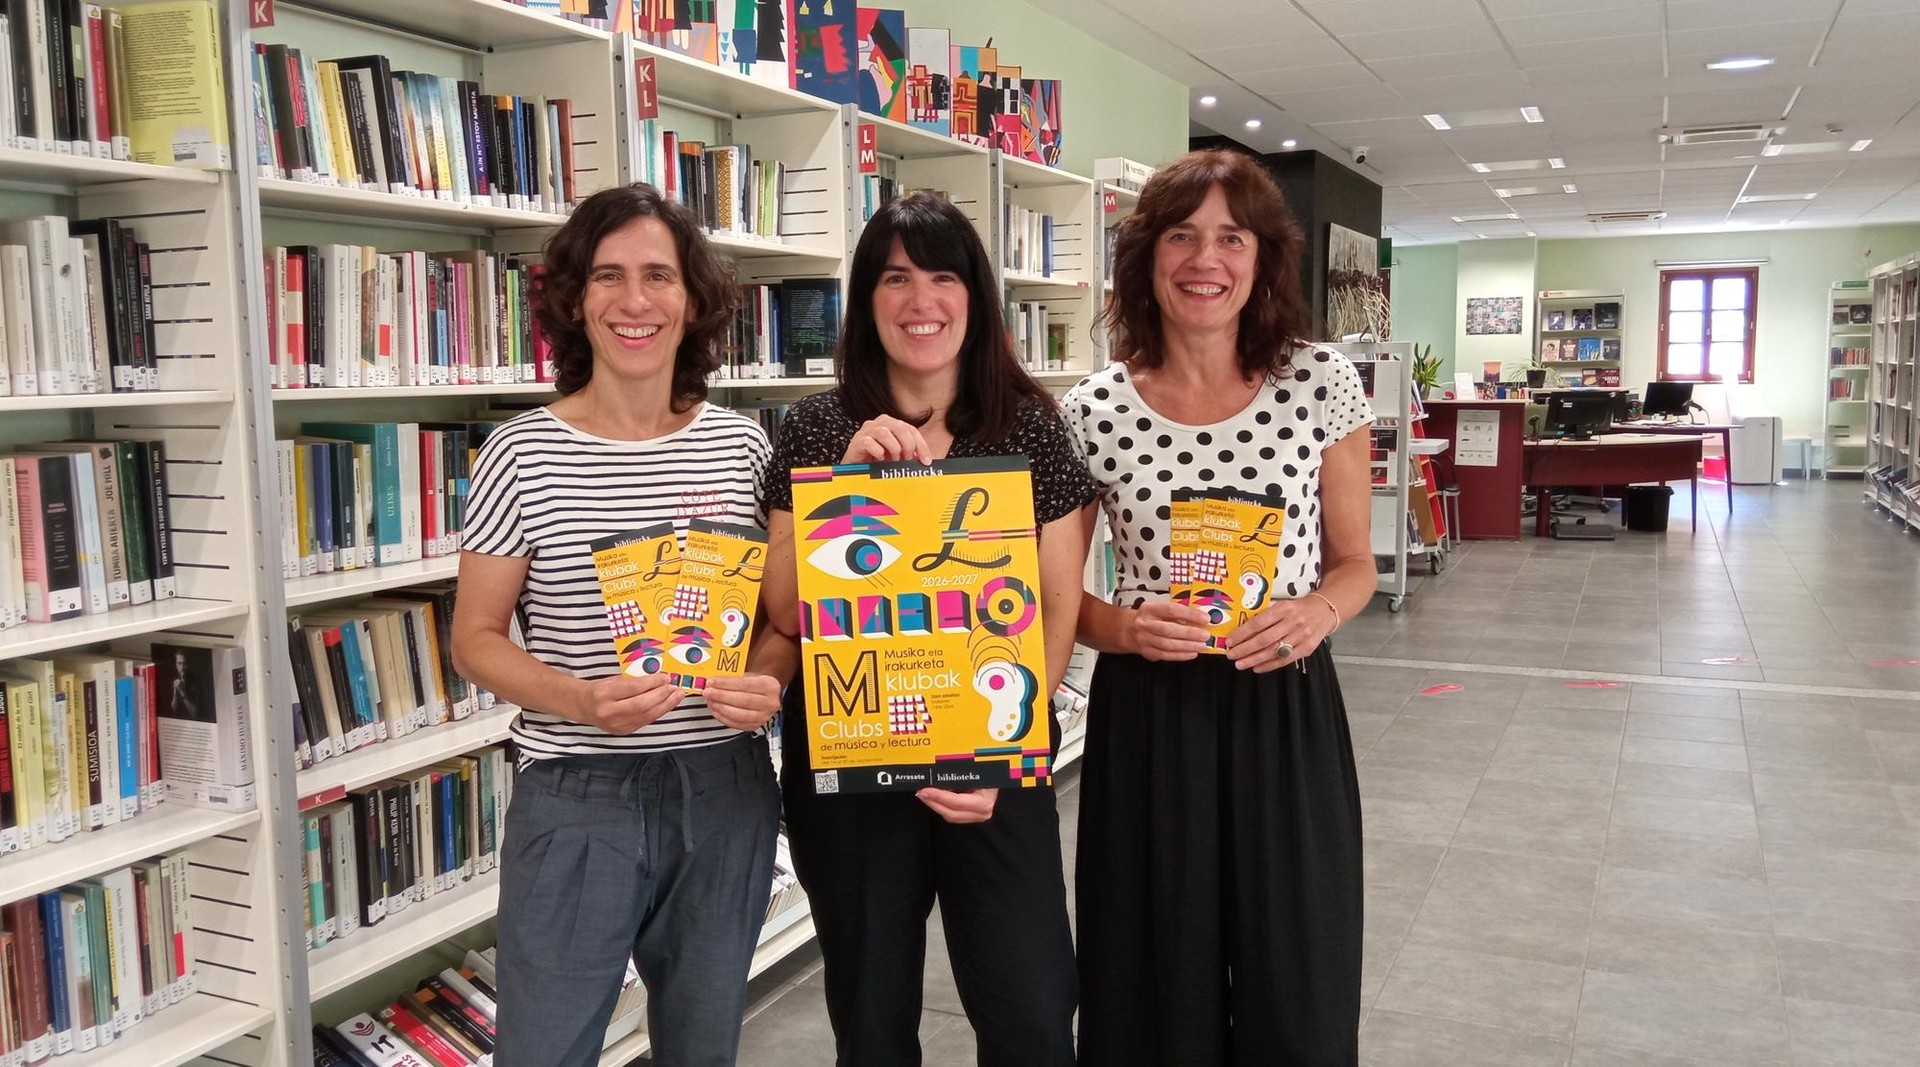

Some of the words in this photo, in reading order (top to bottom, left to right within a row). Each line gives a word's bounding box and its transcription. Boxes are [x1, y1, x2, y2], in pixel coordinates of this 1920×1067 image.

[254, 0, 268, 23] K
[640, 65, 652, 82] K
[644, 91, 652, 108] L
[863, 130, 871, 144] L
[861, 150, 874, 164] M
[1105, 195, 1116, 206] M
[103, 465, 111, 483] HILL
[881, 468, 944, 479] biblioteka
[105, 484, 114, 502] JOE
[107, 509, 119, 547] ABIERTA
[1171, 518, 1200, 527] kluba
[1203, 516, 1241, 529] klubak
[1202, 528, 1234, 542] Clubs
[685, 548, 726, 564] klubak
[111, 548, 122, 580] TUMBA
[598, 562, 639, 579] klubak
[683, 563, 717, 576] Clubs
[603, 578, 638, 593] Clubs
[921, 574, 979, 587] 2026-2027
[716, 649, 741, 672] M
[884, 647, 925, 659] Musika
[928, 649, 943, 657] eta
[884, 658, 944, 671] irakurketa
[814, 650, 880, 717] M
[885, 669, 962, 691] klubak
[820, 719, 884, 740] Clubs
[821, 743, 833, 751] de
[834, 738, 877, 750] música
[880, 741, 886, 749] y
[888, 736, 931, 748] lectura
[89, 730, 99, 783] SUMISIOA
[895, 773, 925, 782] Arrasate
[937, 772, 981, 783] biblioteka
[315, 794, 322, 804] K
